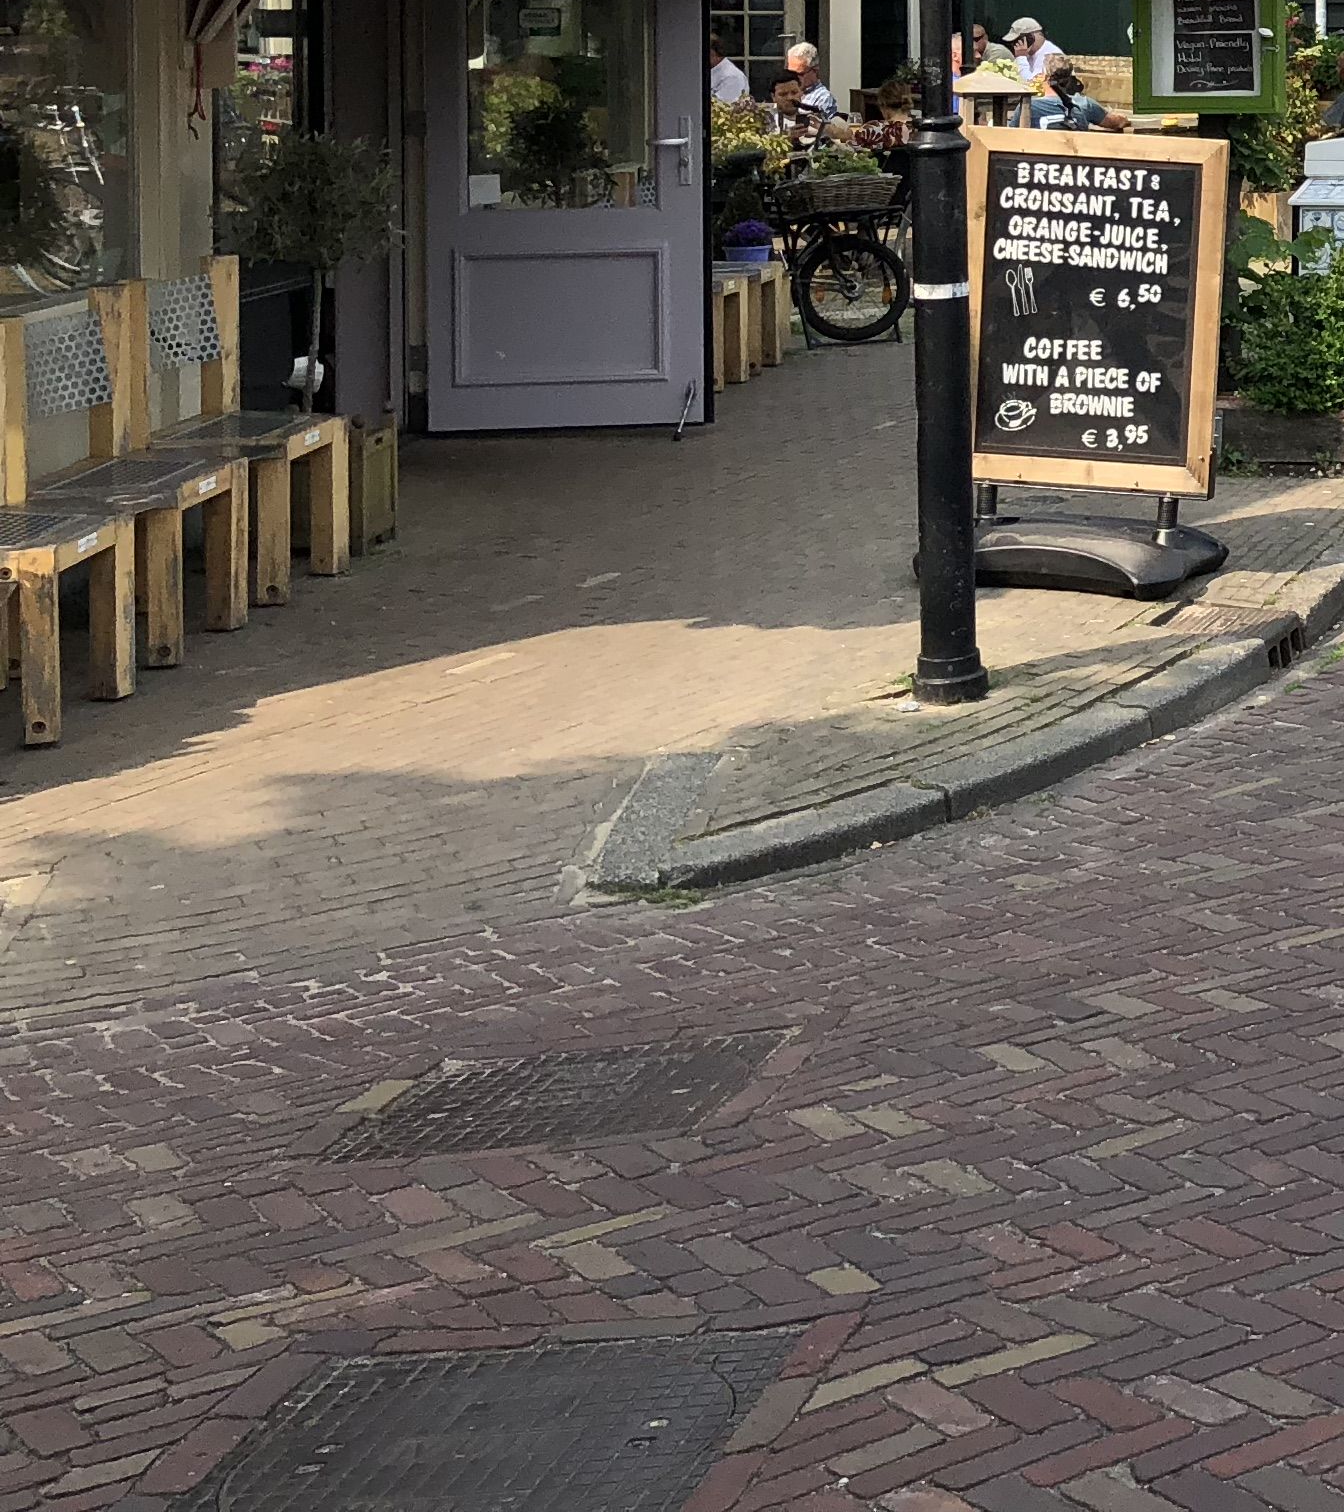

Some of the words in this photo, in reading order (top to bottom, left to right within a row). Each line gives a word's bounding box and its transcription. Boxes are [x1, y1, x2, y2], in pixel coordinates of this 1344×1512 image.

[1000, 187, 1120, 220] CROISSANT,
[1129, 197, 1181, 226] TEA,
[1008, 215, 1168, 251] ORANGE-JUICE,
[993, 238, 1168, 274] CHEESE-SANDWICH
[1023, 337, 1102, 361] COFFEE
[1002, 363, 1048, 387] WITH
[1055, 365, 1069, 387] A
[1075, 366, 1129, 389] PIECE
[1136, 371, 1161, 393] OF
[1050, 392, 1134, 417] BROWNIE
